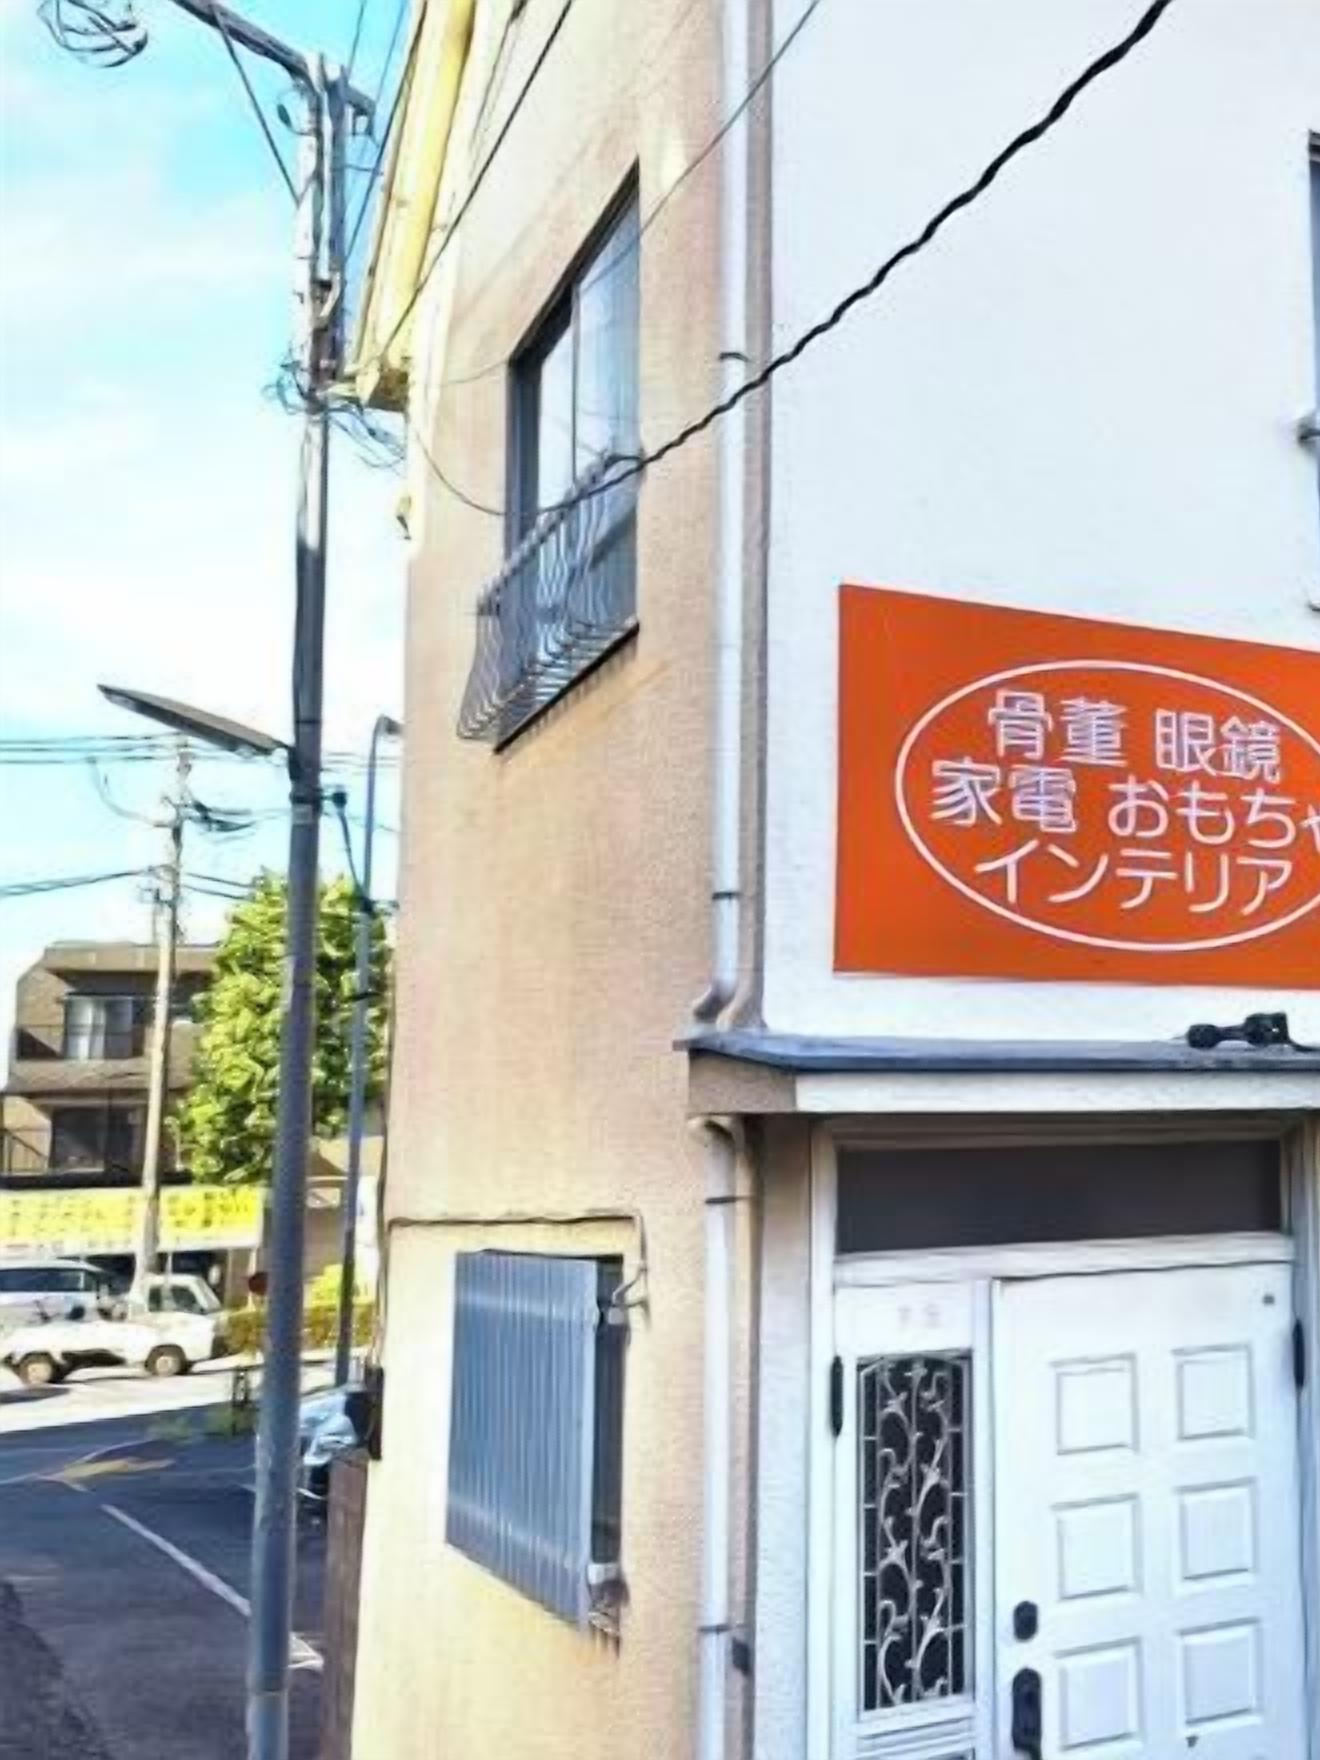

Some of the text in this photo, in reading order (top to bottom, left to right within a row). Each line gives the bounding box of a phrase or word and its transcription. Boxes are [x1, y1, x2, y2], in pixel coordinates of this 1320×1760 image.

[988, 688, 1282, 784] 骨董 眼鏡
[930, 756, 1077, 834] 家電
[974, 838, 1293, 916] インテリア
